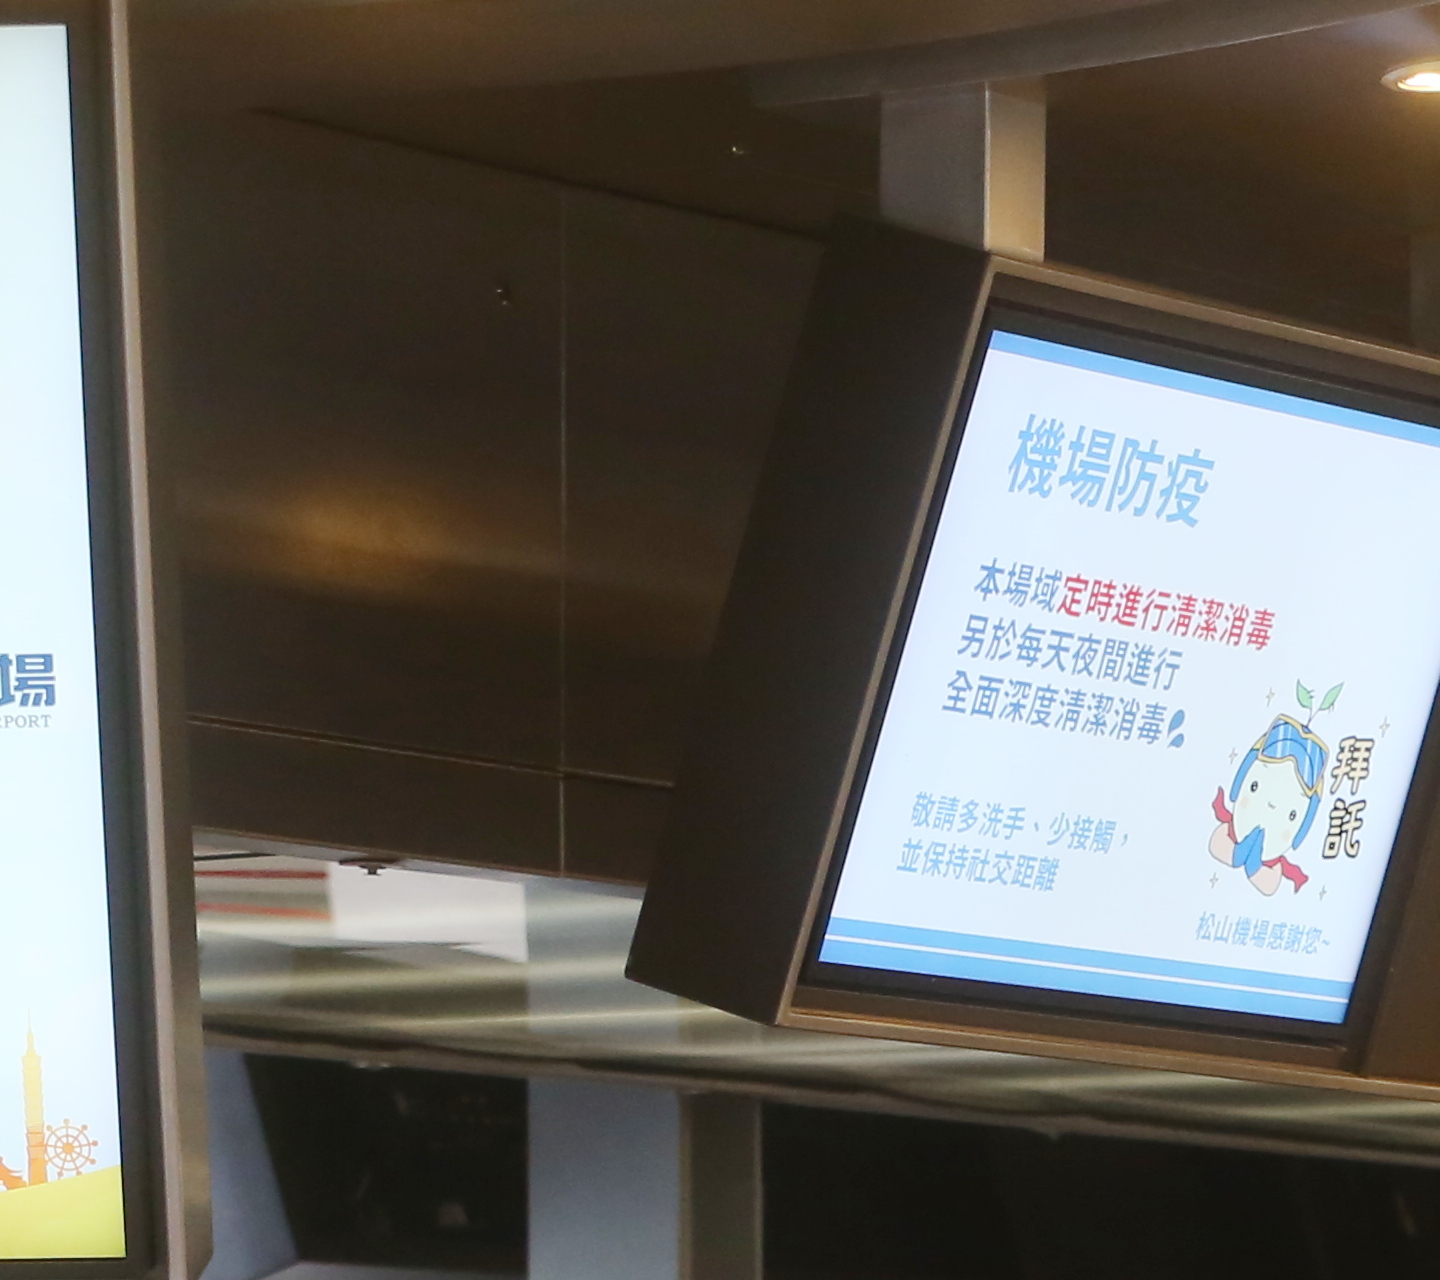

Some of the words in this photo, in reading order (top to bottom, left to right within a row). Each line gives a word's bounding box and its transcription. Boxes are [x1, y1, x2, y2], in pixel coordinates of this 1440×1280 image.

[1007, 414, 1215, 527] 機場防疫
[973, 558, 1276, 651] 本場域定時進行清潔消毒
[957, 614, 1184, 691] 另於每天夜間進行
[0, 714, 52, 729] PORT
[942, 671, 1167, 745] 全面深度清潔消毒
[1322, 736, 1375, 859] 拜託
[896, 838, 1060, 892] 並保持社交距離
